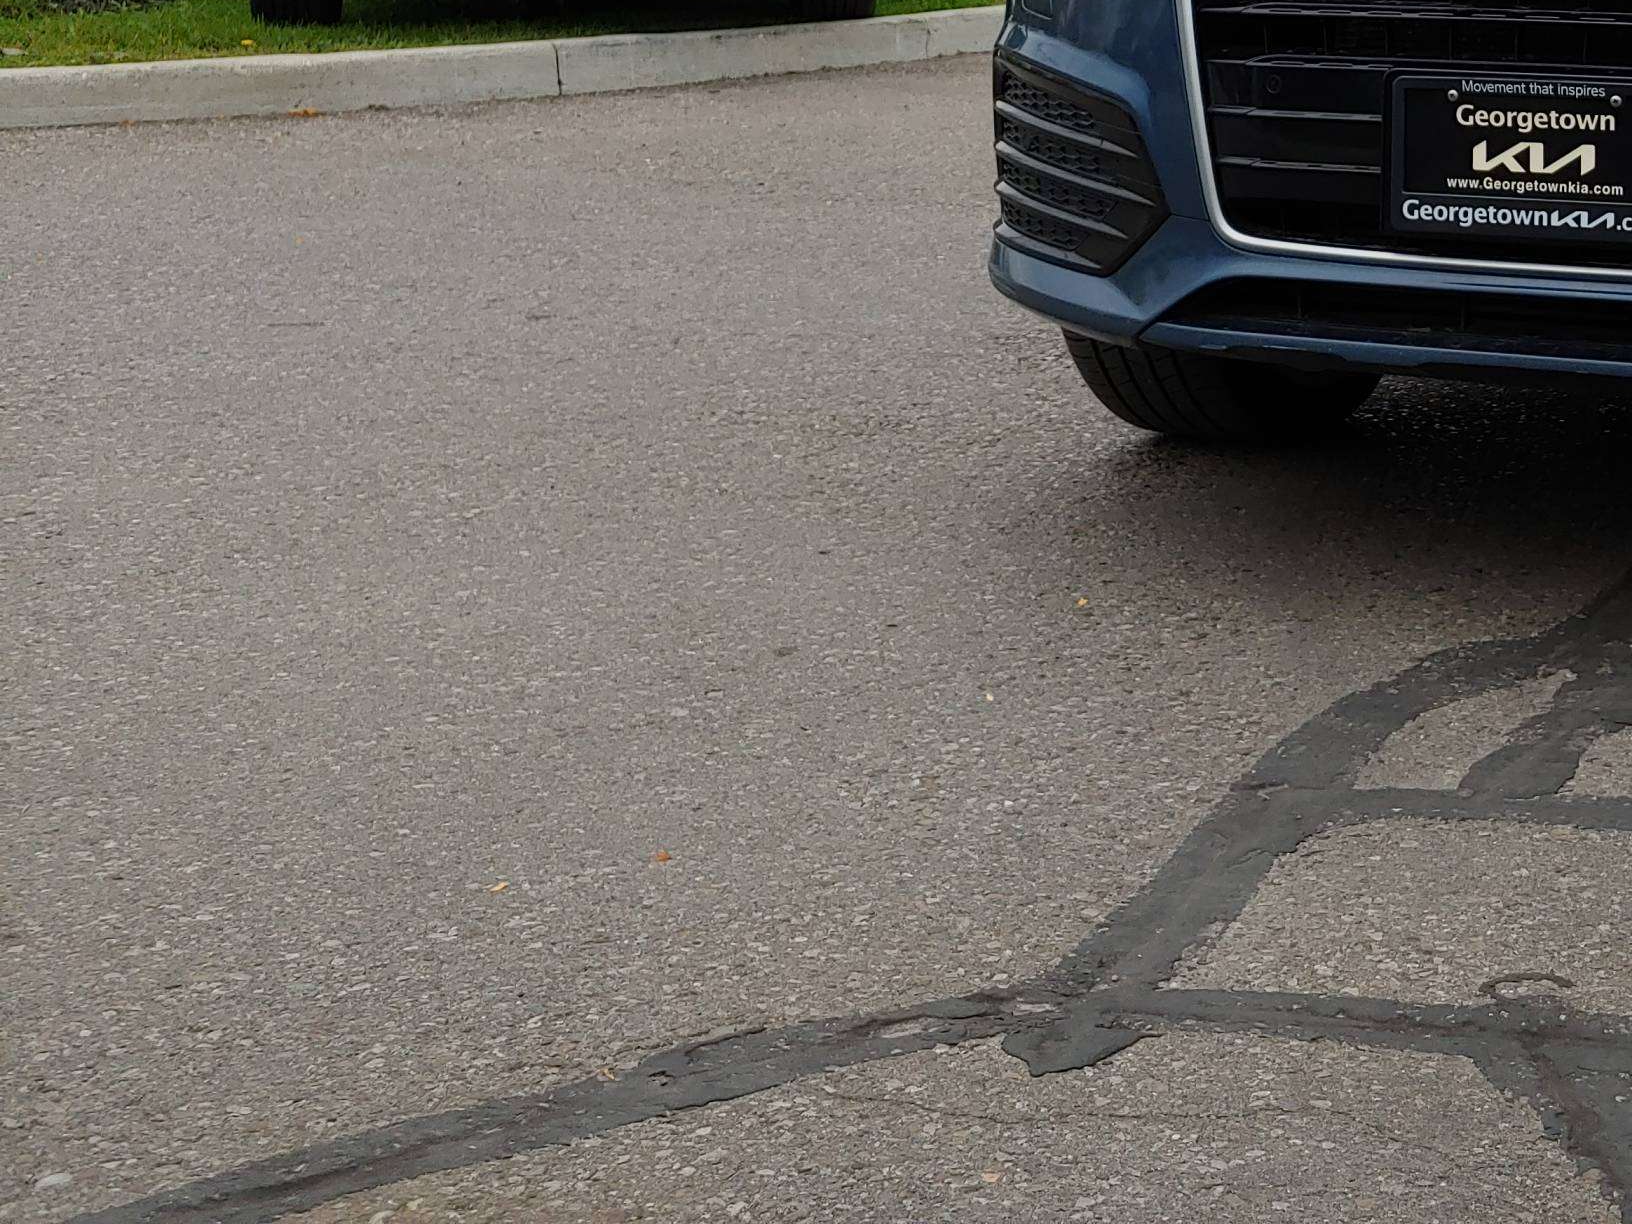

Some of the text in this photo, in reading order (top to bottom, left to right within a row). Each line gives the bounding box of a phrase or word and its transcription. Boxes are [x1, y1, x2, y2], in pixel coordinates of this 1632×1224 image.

[1461, 79, 1606, 99] Movement that inspires
[1456, 104, 1616, 133] Georgetown
[1472, 140, 1596, 176] KIA
[1447, 177, 1624, 196] www.Georgetownkia.com
